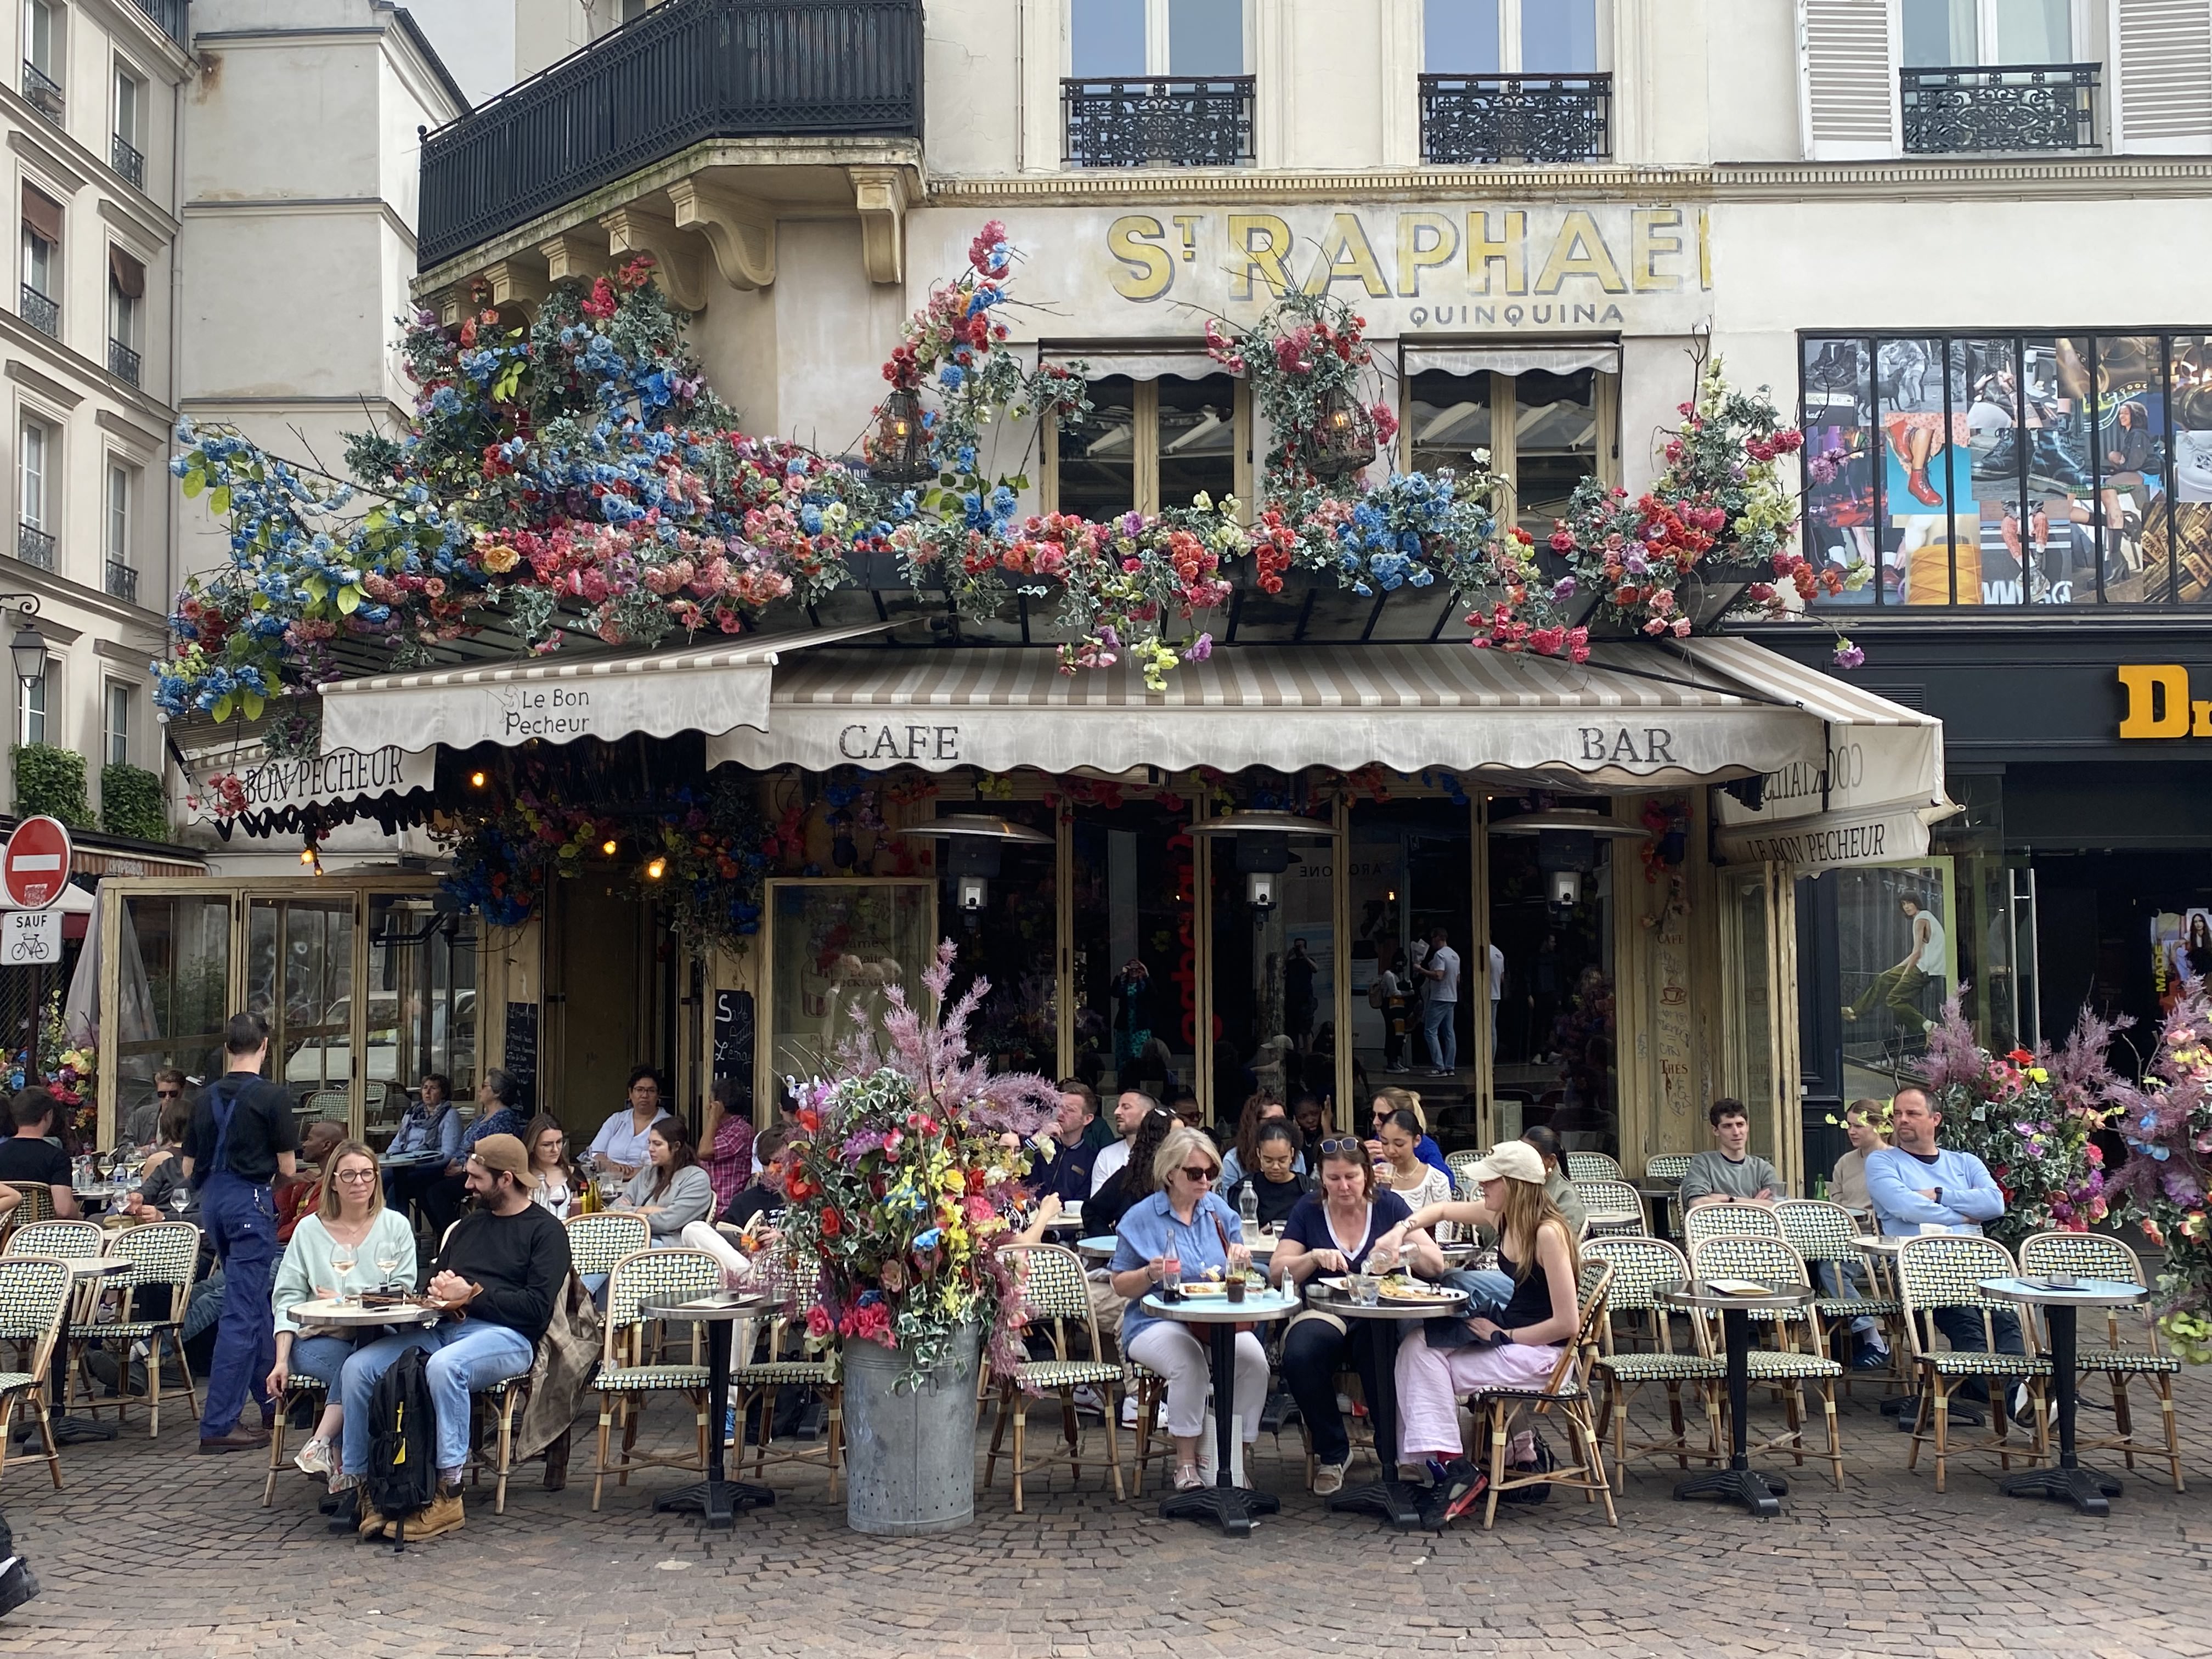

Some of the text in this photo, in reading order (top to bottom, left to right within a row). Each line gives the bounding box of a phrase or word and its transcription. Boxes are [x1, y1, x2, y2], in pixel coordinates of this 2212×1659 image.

[1409, 303, 1624, 328] QUINQUINA
[523, 689, 589, 709] Le Bon
[505, 712, 590, 736] Pecheur
[839, 725, 958, 760] CAFE
[1578, 727, 1677, 762] BAR
[246, 744, 403, 804] BON PECHEUR
[1769, 836, 1805, 863] BON
[1805, 823, 1884, 862] PECHEUR
[16, 915, 47, 928] SAUF
[2155, 945, 2166, 992] MADE
